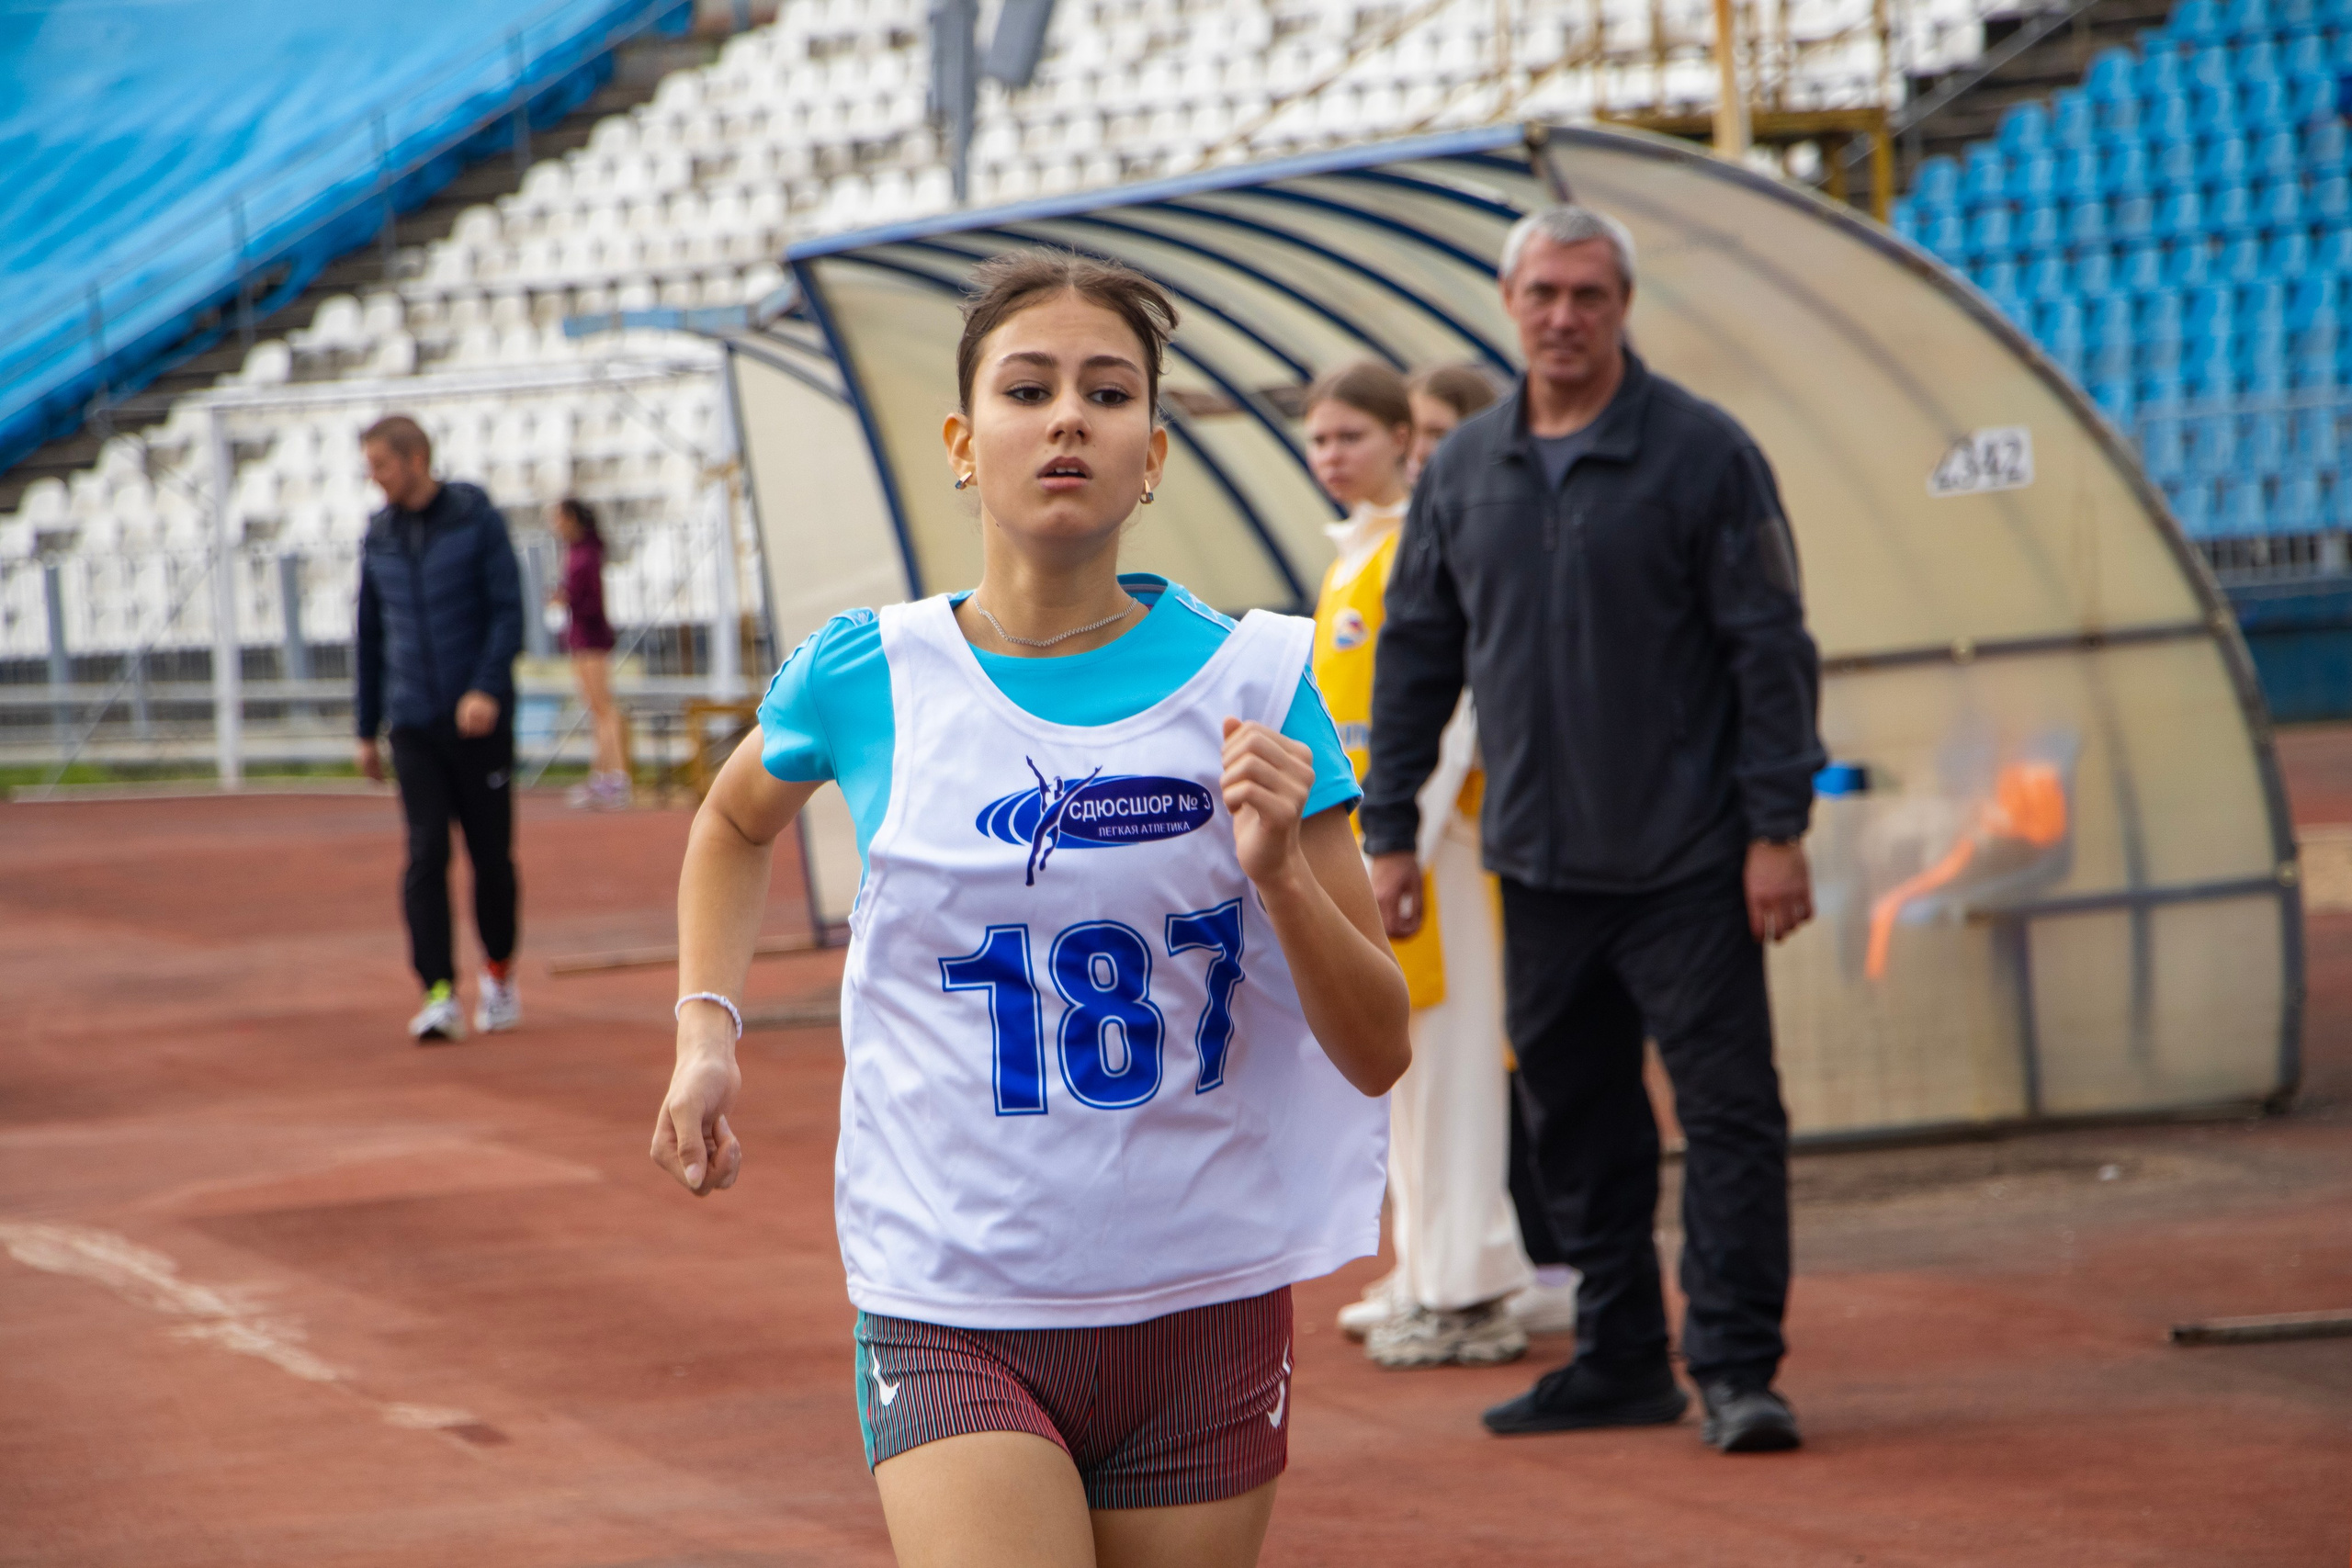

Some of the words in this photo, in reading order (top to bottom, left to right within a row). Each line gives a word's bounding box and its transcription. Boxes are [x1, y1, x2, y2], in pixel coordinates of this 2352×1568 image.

[1069, 795, 1173, 821] СДЮСШОР
[1179, 794, 1198, 811] №
[1203, 792, 1212, 810] 3
[938, 897, 1245, 1117] 187
